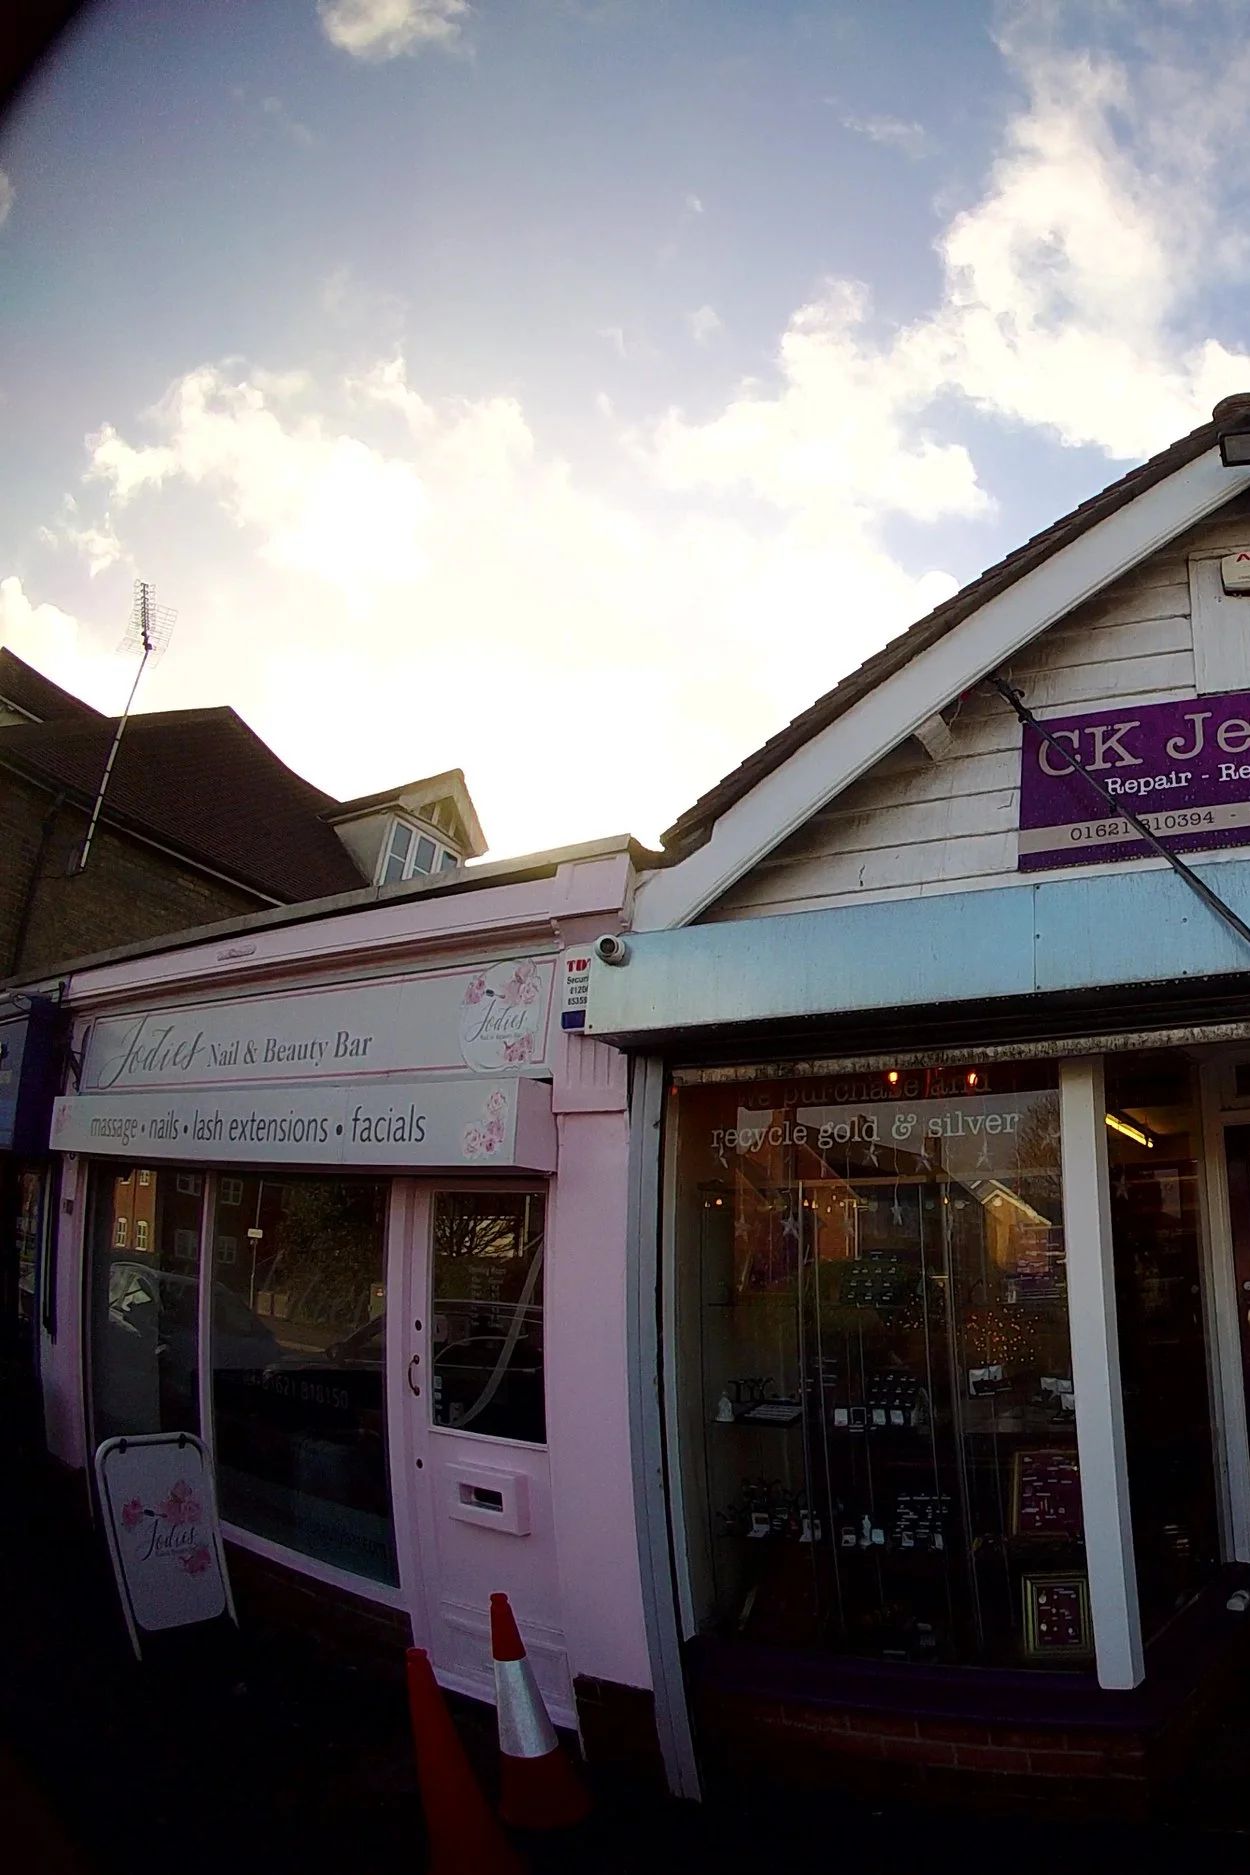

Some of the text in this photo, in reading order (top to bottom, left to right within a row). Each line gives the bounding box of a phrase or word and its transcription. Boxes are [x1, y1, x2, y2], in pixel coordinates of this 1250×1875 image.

[1038, 720, 1143, 777] CK
[1104, 771, 1192, 795] Repair
[1070, 822, 1131, 841] 01621
[97, 1013, 373, 1090] Jodies Nail & Beauty Bar
[783, 1072, 919, 1108] purchase
[90, 1103, 427, 1147] massage nails lash extensions facials
[711, 1111, 1020, 1150] recycle gold & silver
